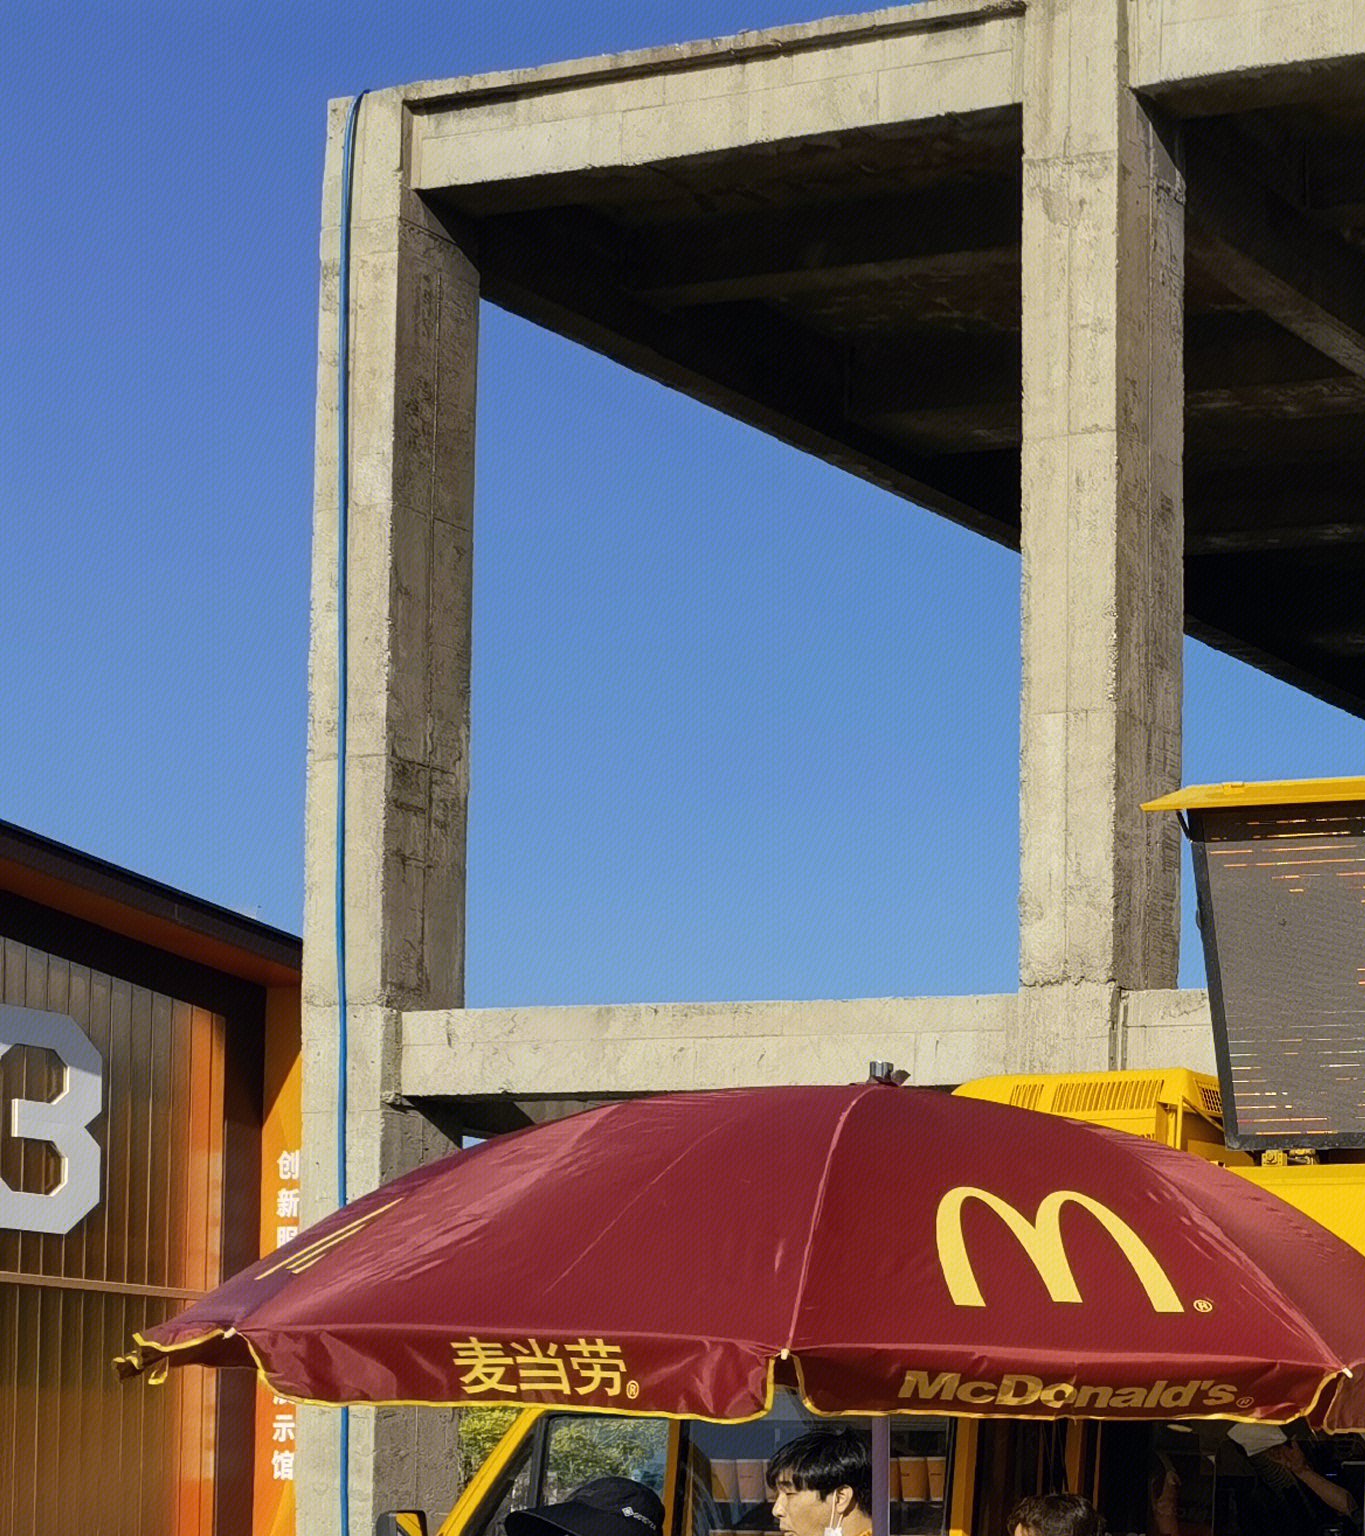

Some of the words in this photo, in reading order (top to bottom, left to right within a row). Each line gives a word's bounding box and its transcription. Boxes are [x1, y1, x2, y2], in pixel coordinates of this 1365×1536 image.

[0, 1002, 102, 1234] 3
[450, 1336, 627, 1397] 麦当劳
[897, 1370, 1239, 1408] McDonald's
